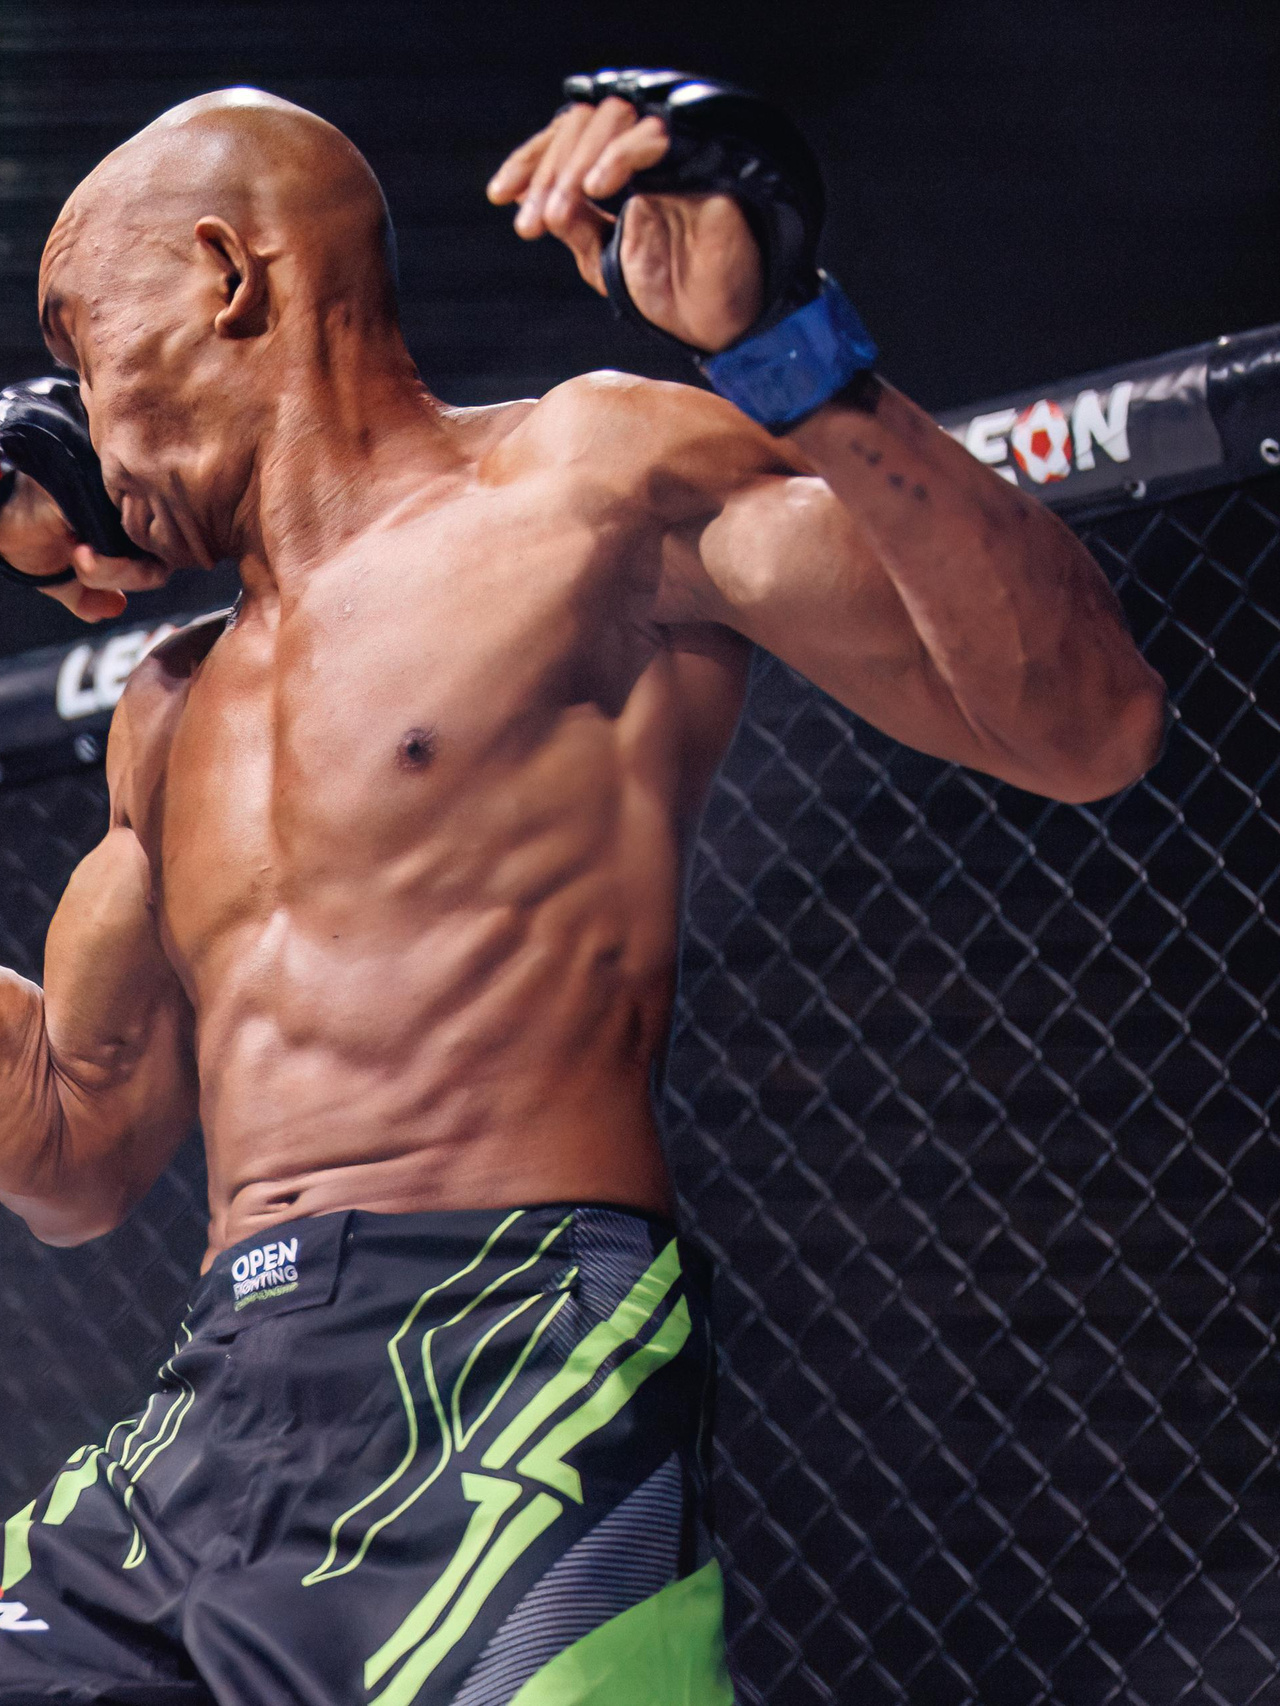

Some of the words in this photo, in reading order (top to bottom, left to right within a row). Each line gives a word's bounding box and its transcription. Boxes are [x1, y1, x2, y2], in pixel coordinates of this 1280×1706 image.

[965, 380, 1133, 486] EON
[56, 622, 179, 719] LE
[231, 1237, 298, 1282] OPEN
